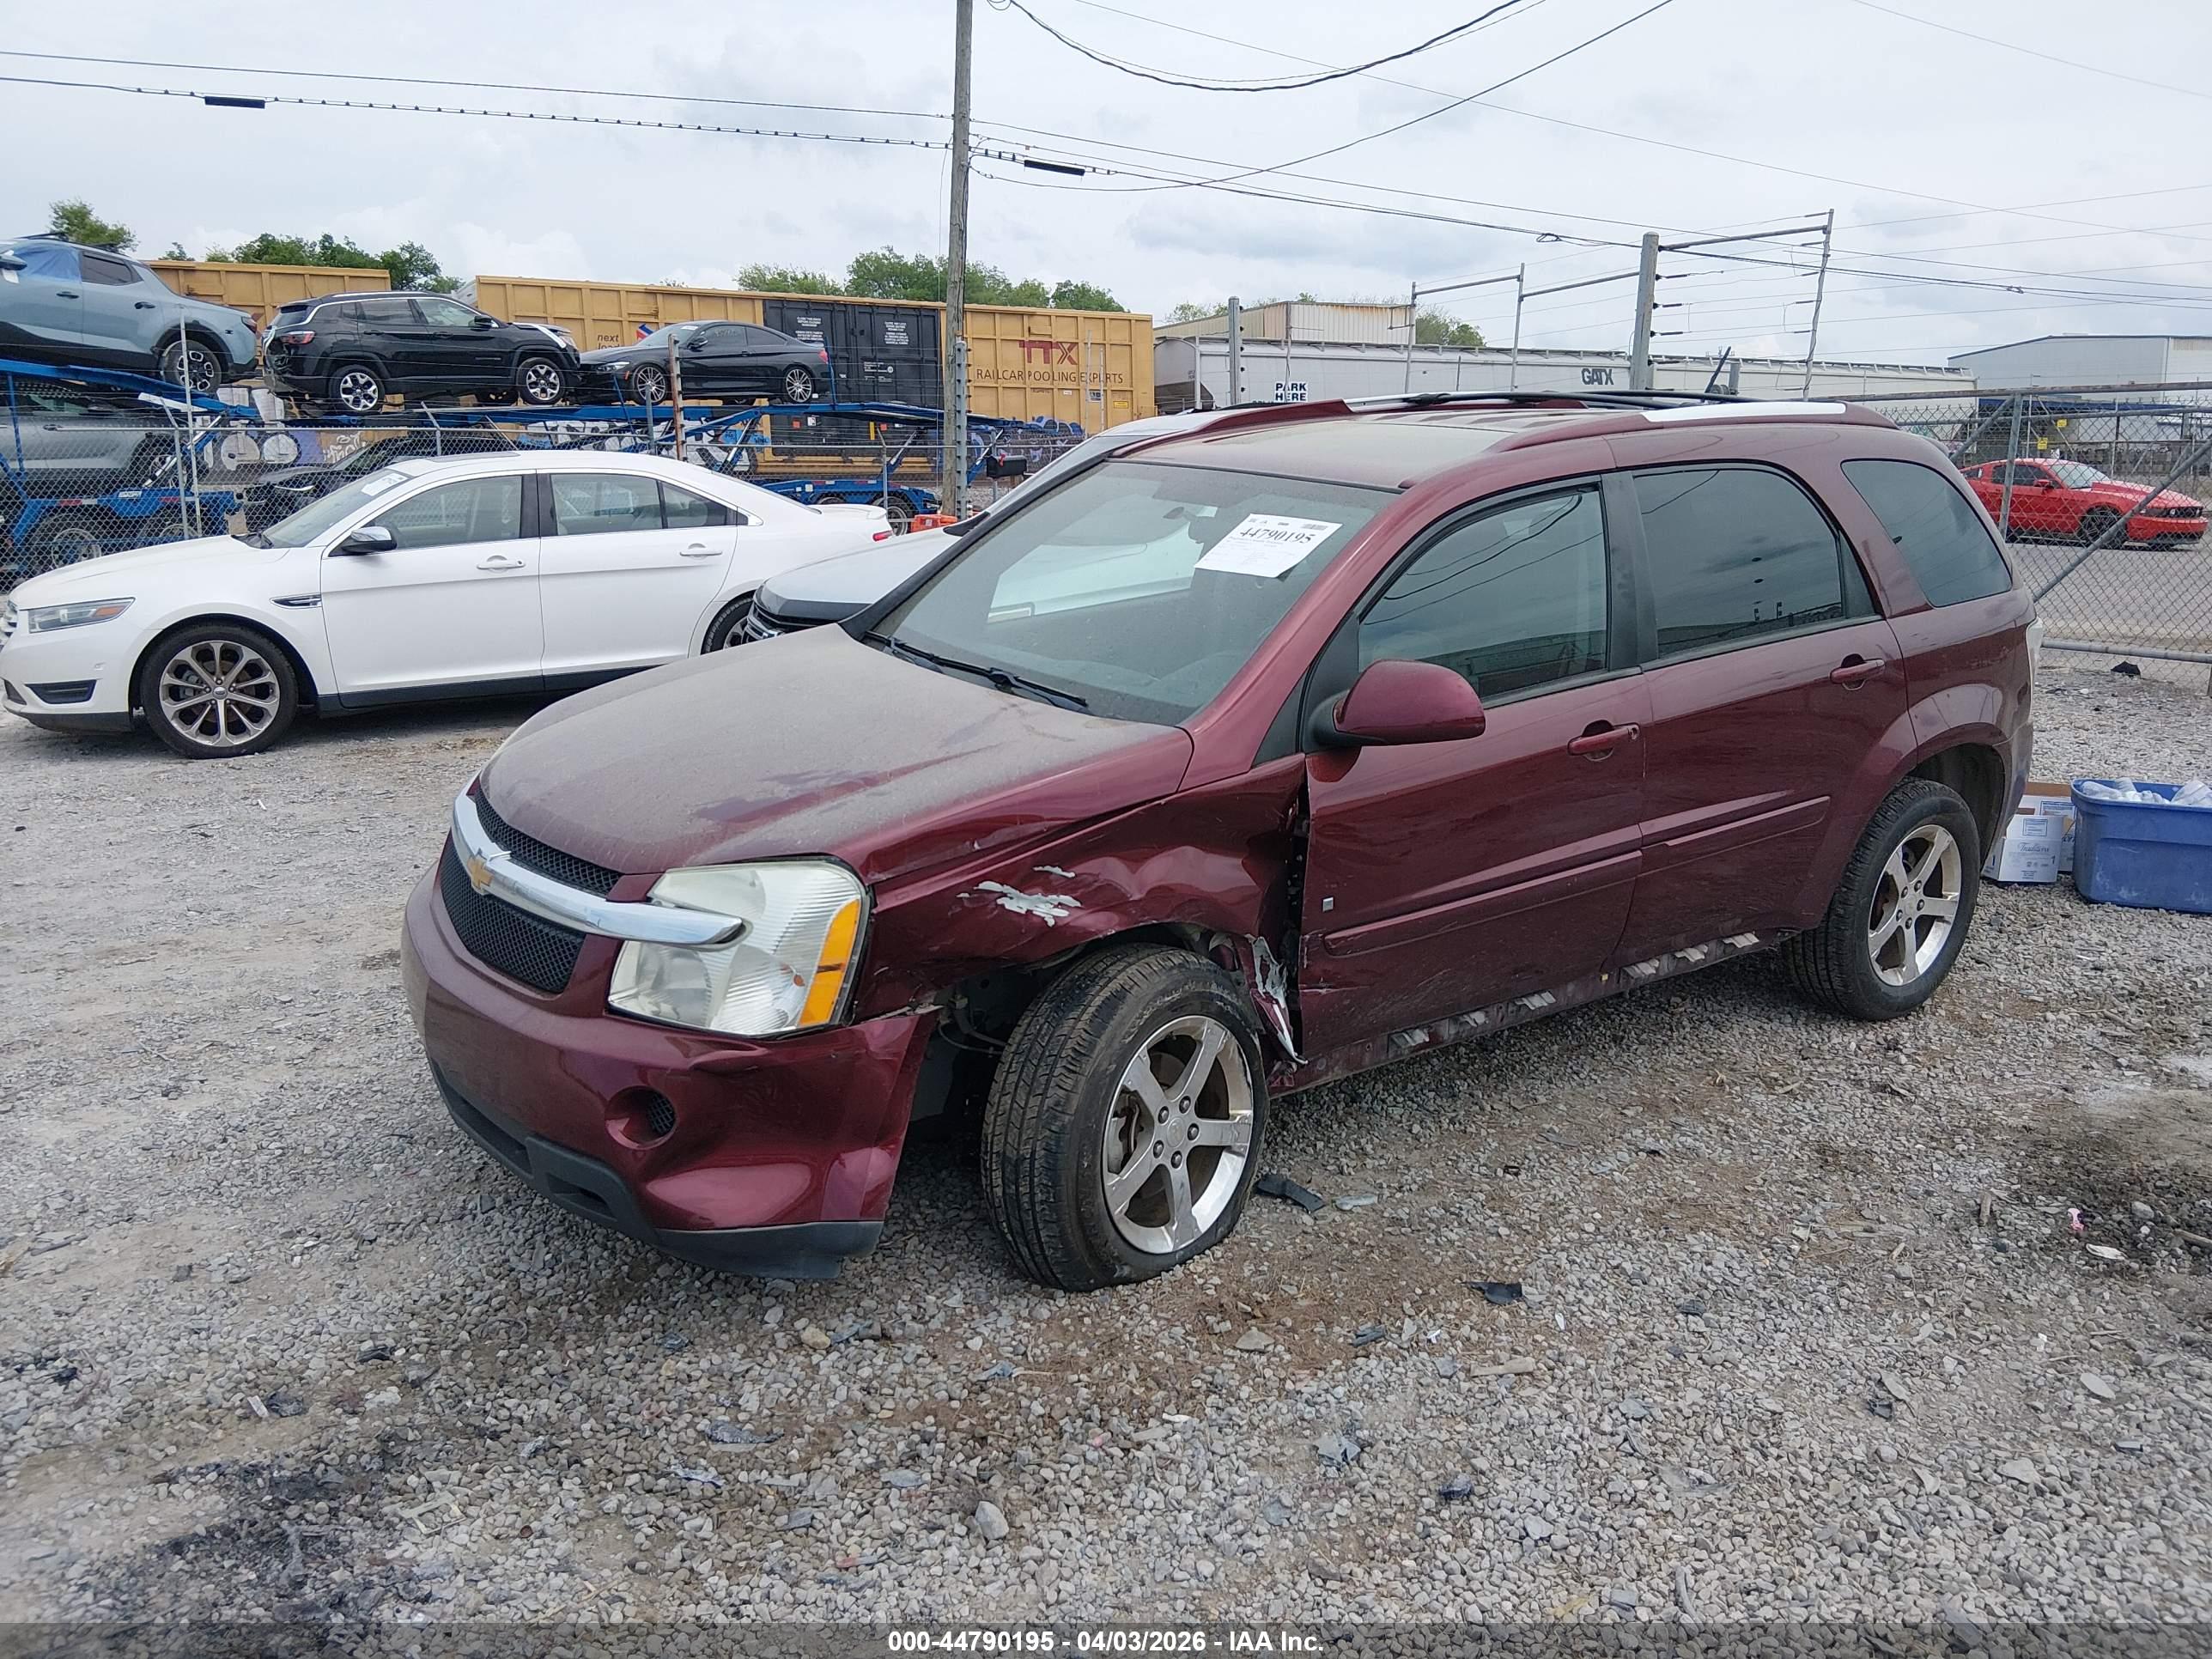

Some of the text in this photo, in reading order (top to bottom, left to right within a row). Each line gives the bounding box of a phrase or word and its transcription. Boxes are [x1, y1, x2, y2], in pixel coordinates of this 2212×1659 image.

[1019, 340, 1079, 365] TTX
[976, 369, 1024, 381] RAILCAR
[1028, 371, 1076, 383] POOLING
[1581, 368, 1614, 385] GATX
[1276, 383, 1307, 392] PARK
[1275, 392, 1306, 401] HERE
[1240, 527, 1316, 543] 44790195
